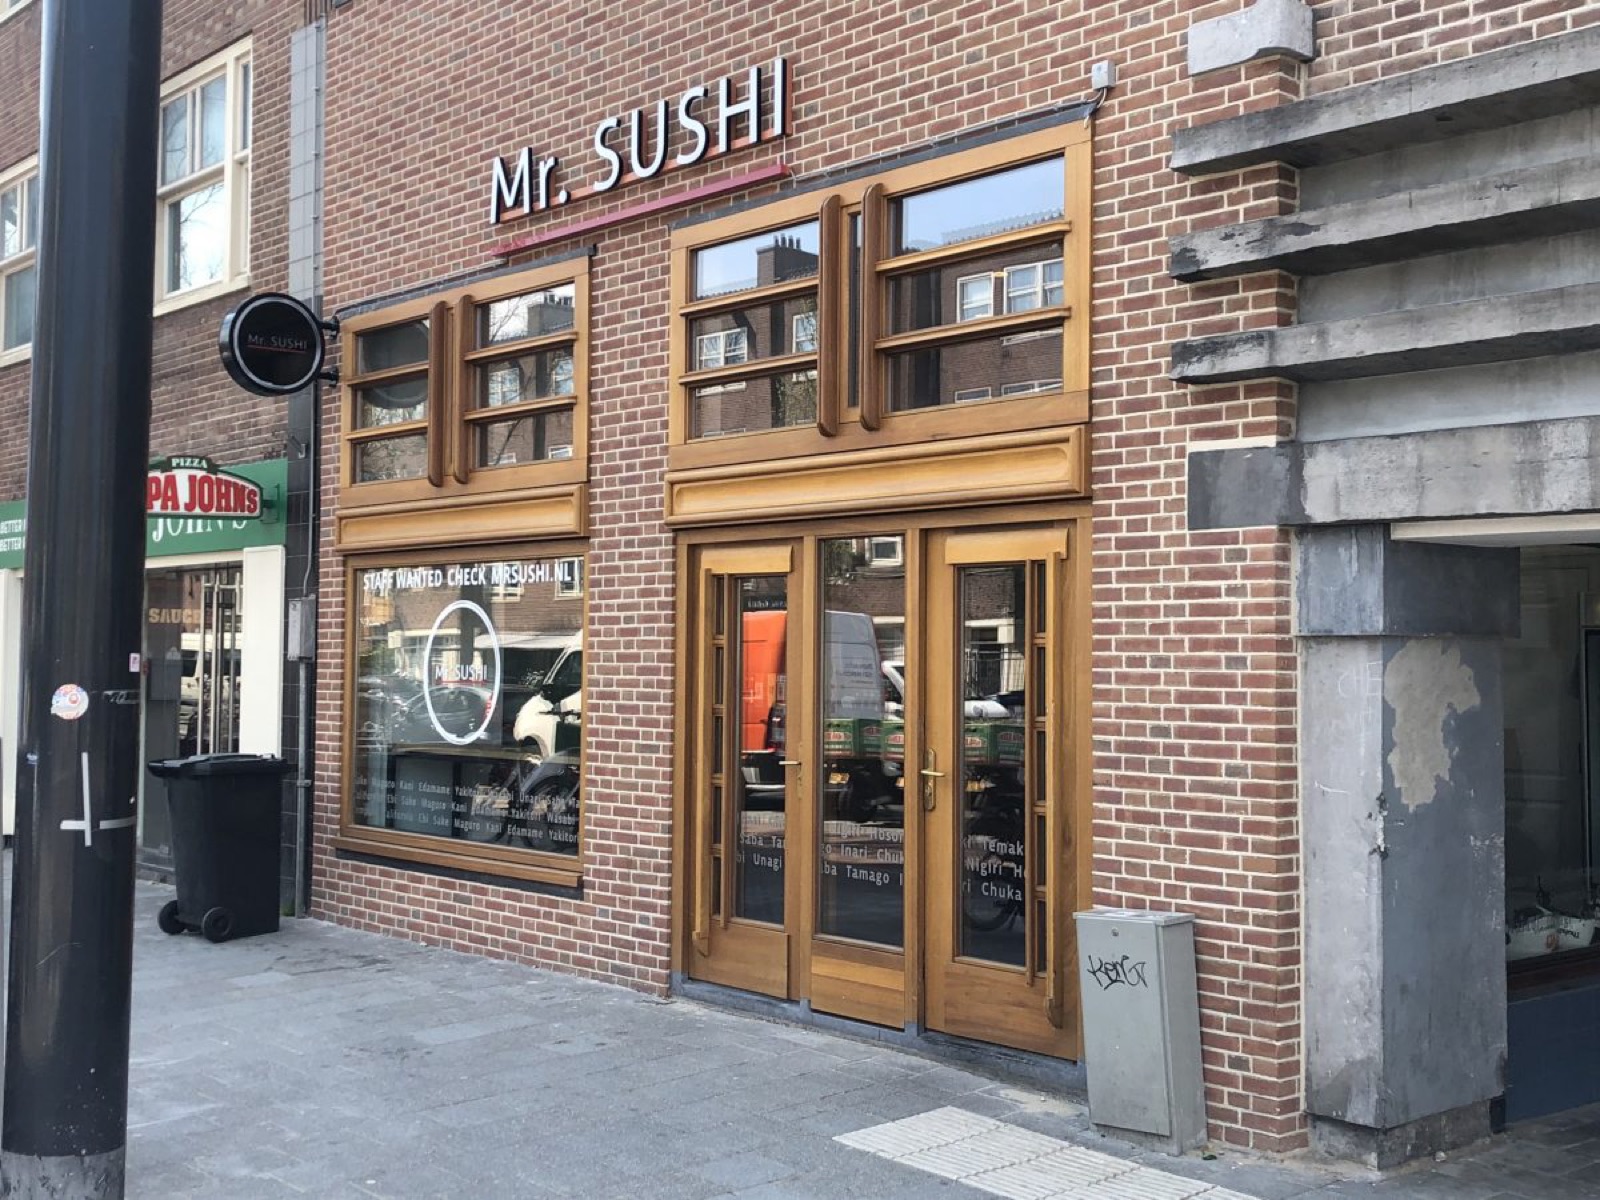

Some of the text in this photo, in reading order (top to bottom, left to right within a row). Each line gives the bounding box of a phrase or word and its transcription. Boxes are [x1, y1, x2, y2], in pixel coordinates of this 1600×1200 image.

[490, 57, 787, 224] Mr. SUSHI
[271, 335, 308, 349] SUSHI
[171, 458, 208, 469] PIZZA
[146, 474, 180, 511] PA
[363, 562, 572, 590] STAFF WANTED CHECK MRSUSHI.NL
[455, 664, 487, 681] SUSHI
[400, 780, 414, 790] Kani
[418, 781, 450, 794] Edamame
[454, 818, 481, 832] Maguro
[507, 823, 544, 839] Edamame
[841, 843, 868, 859] Inari
[752, 852, 782, 872] Unagi
[966, 856, 1003, 877] Nigiri
[846, 864, 890, 887] Tamago
[981, 881, 1022, 901] Chuka
